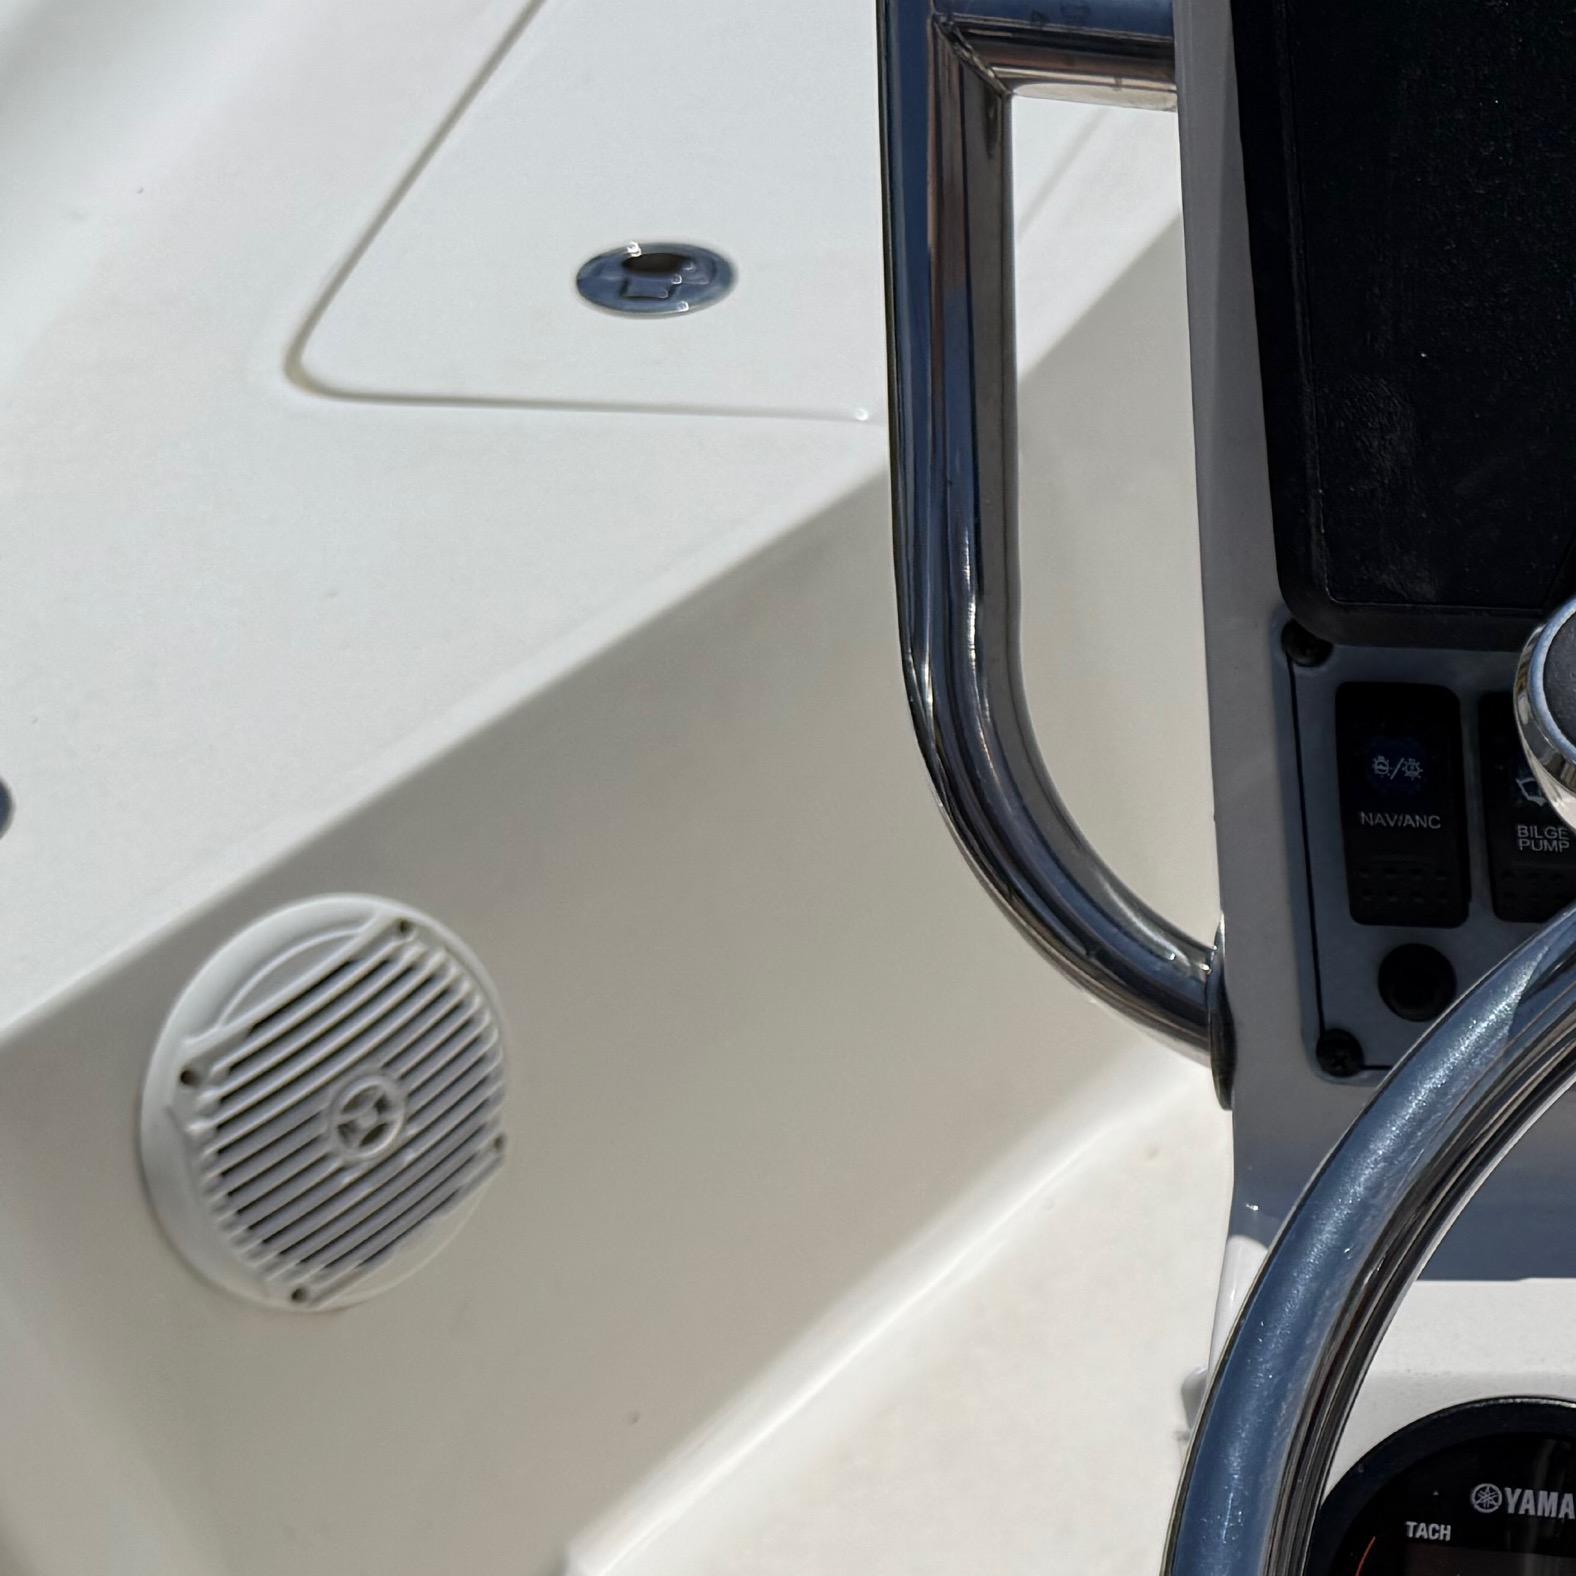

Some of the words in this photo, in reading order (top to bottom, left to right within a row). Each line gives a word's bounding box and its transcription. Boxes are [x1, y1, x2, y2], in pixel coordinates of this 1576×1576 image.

[1360, 811, 1442, 830] NAV/ANC
[1517, 824, 1569, 840] BILGE
[1518, 838, 1571, 853] PUMP
[1405, 1520, 1452, 1542] TACH
